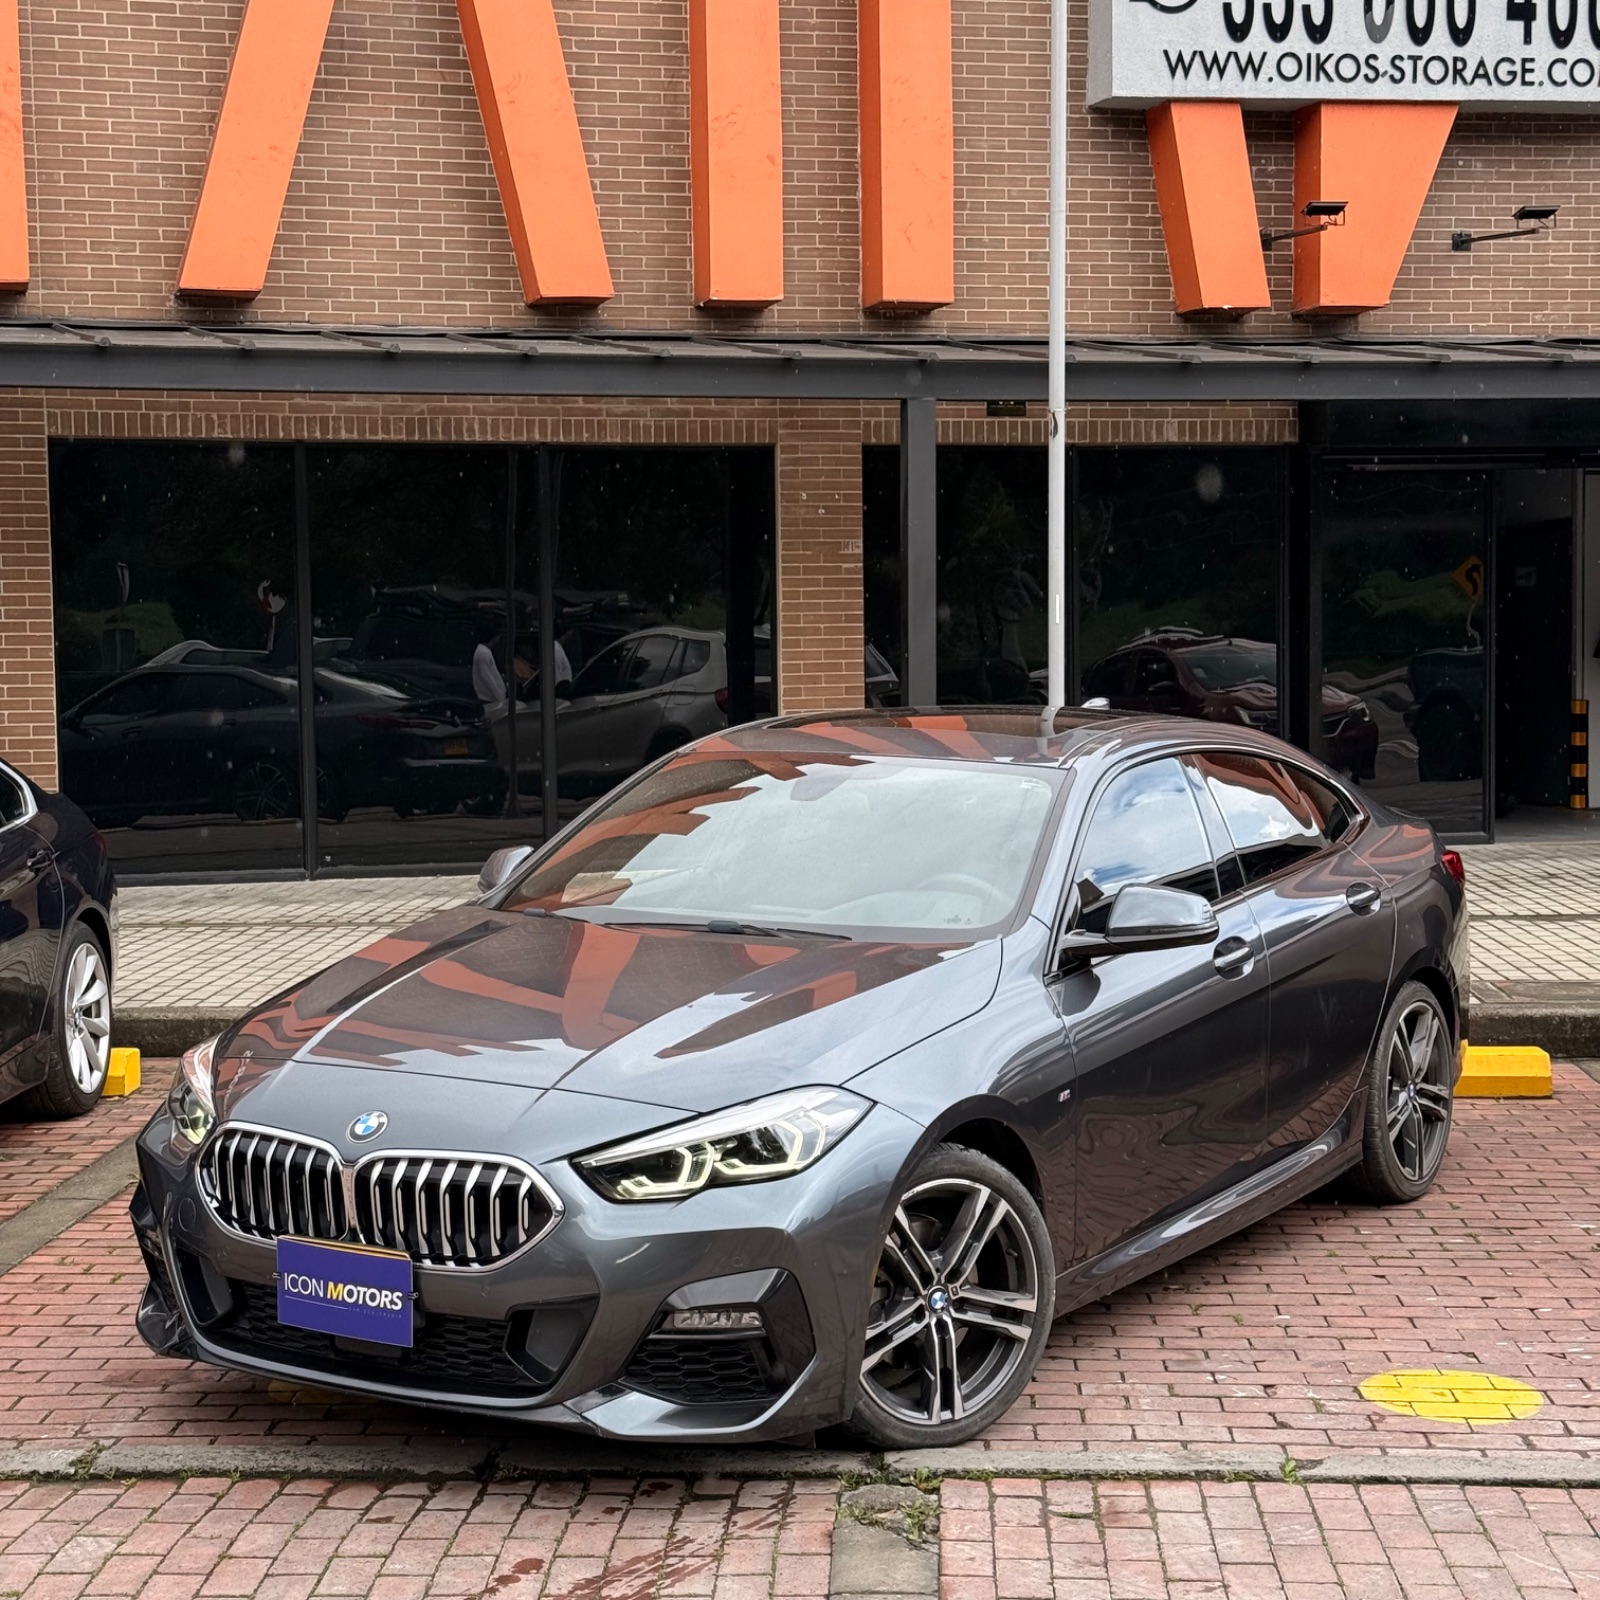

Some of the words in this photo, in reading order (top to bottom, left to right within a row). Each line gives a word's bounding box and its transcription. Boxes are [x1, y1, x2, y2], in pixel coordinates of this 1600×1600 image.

[1163, 49, 1600, 87] WWW.OIKOS-STORAGE.CO
[284, 1272, 324, 1298] ICON
[327, 1281, 403, 1311] MOTORS
